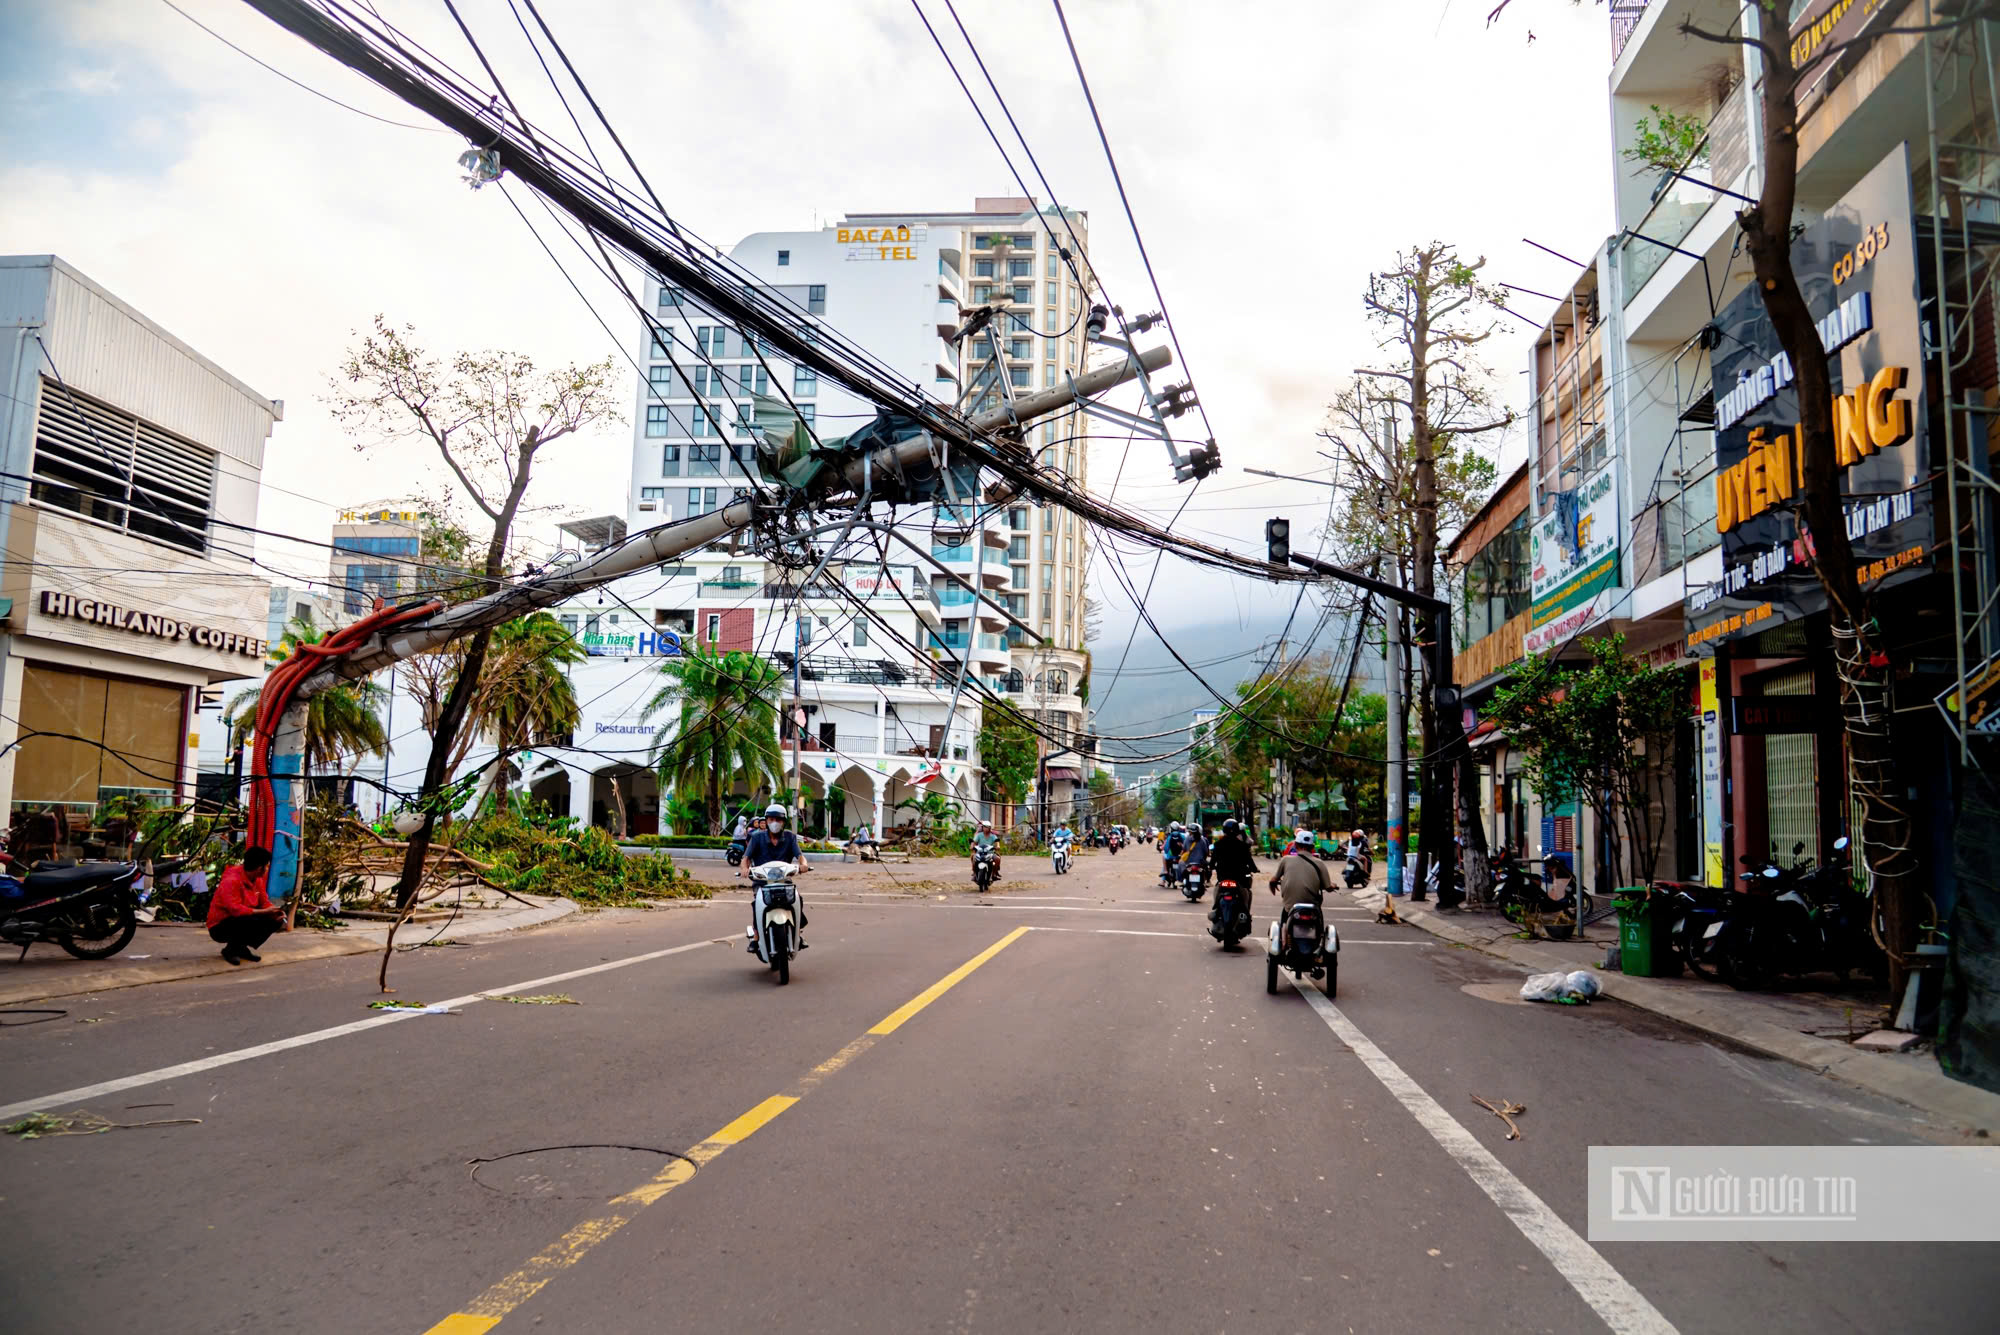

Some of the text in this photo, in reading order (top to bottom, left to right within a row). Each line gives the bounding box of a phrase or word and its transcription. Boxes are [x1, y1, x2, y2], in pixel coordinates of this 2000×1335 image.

[837, 228, 911, 244] BACAD
[877, 246, 917, 261] TEL
[41, 590, 191, 641] HIGHLANDS
[191, 625, 268, 658] COFFEE
[638, 631, 682, 655] HQ
[595, 722, 656, 734] Restaurant
